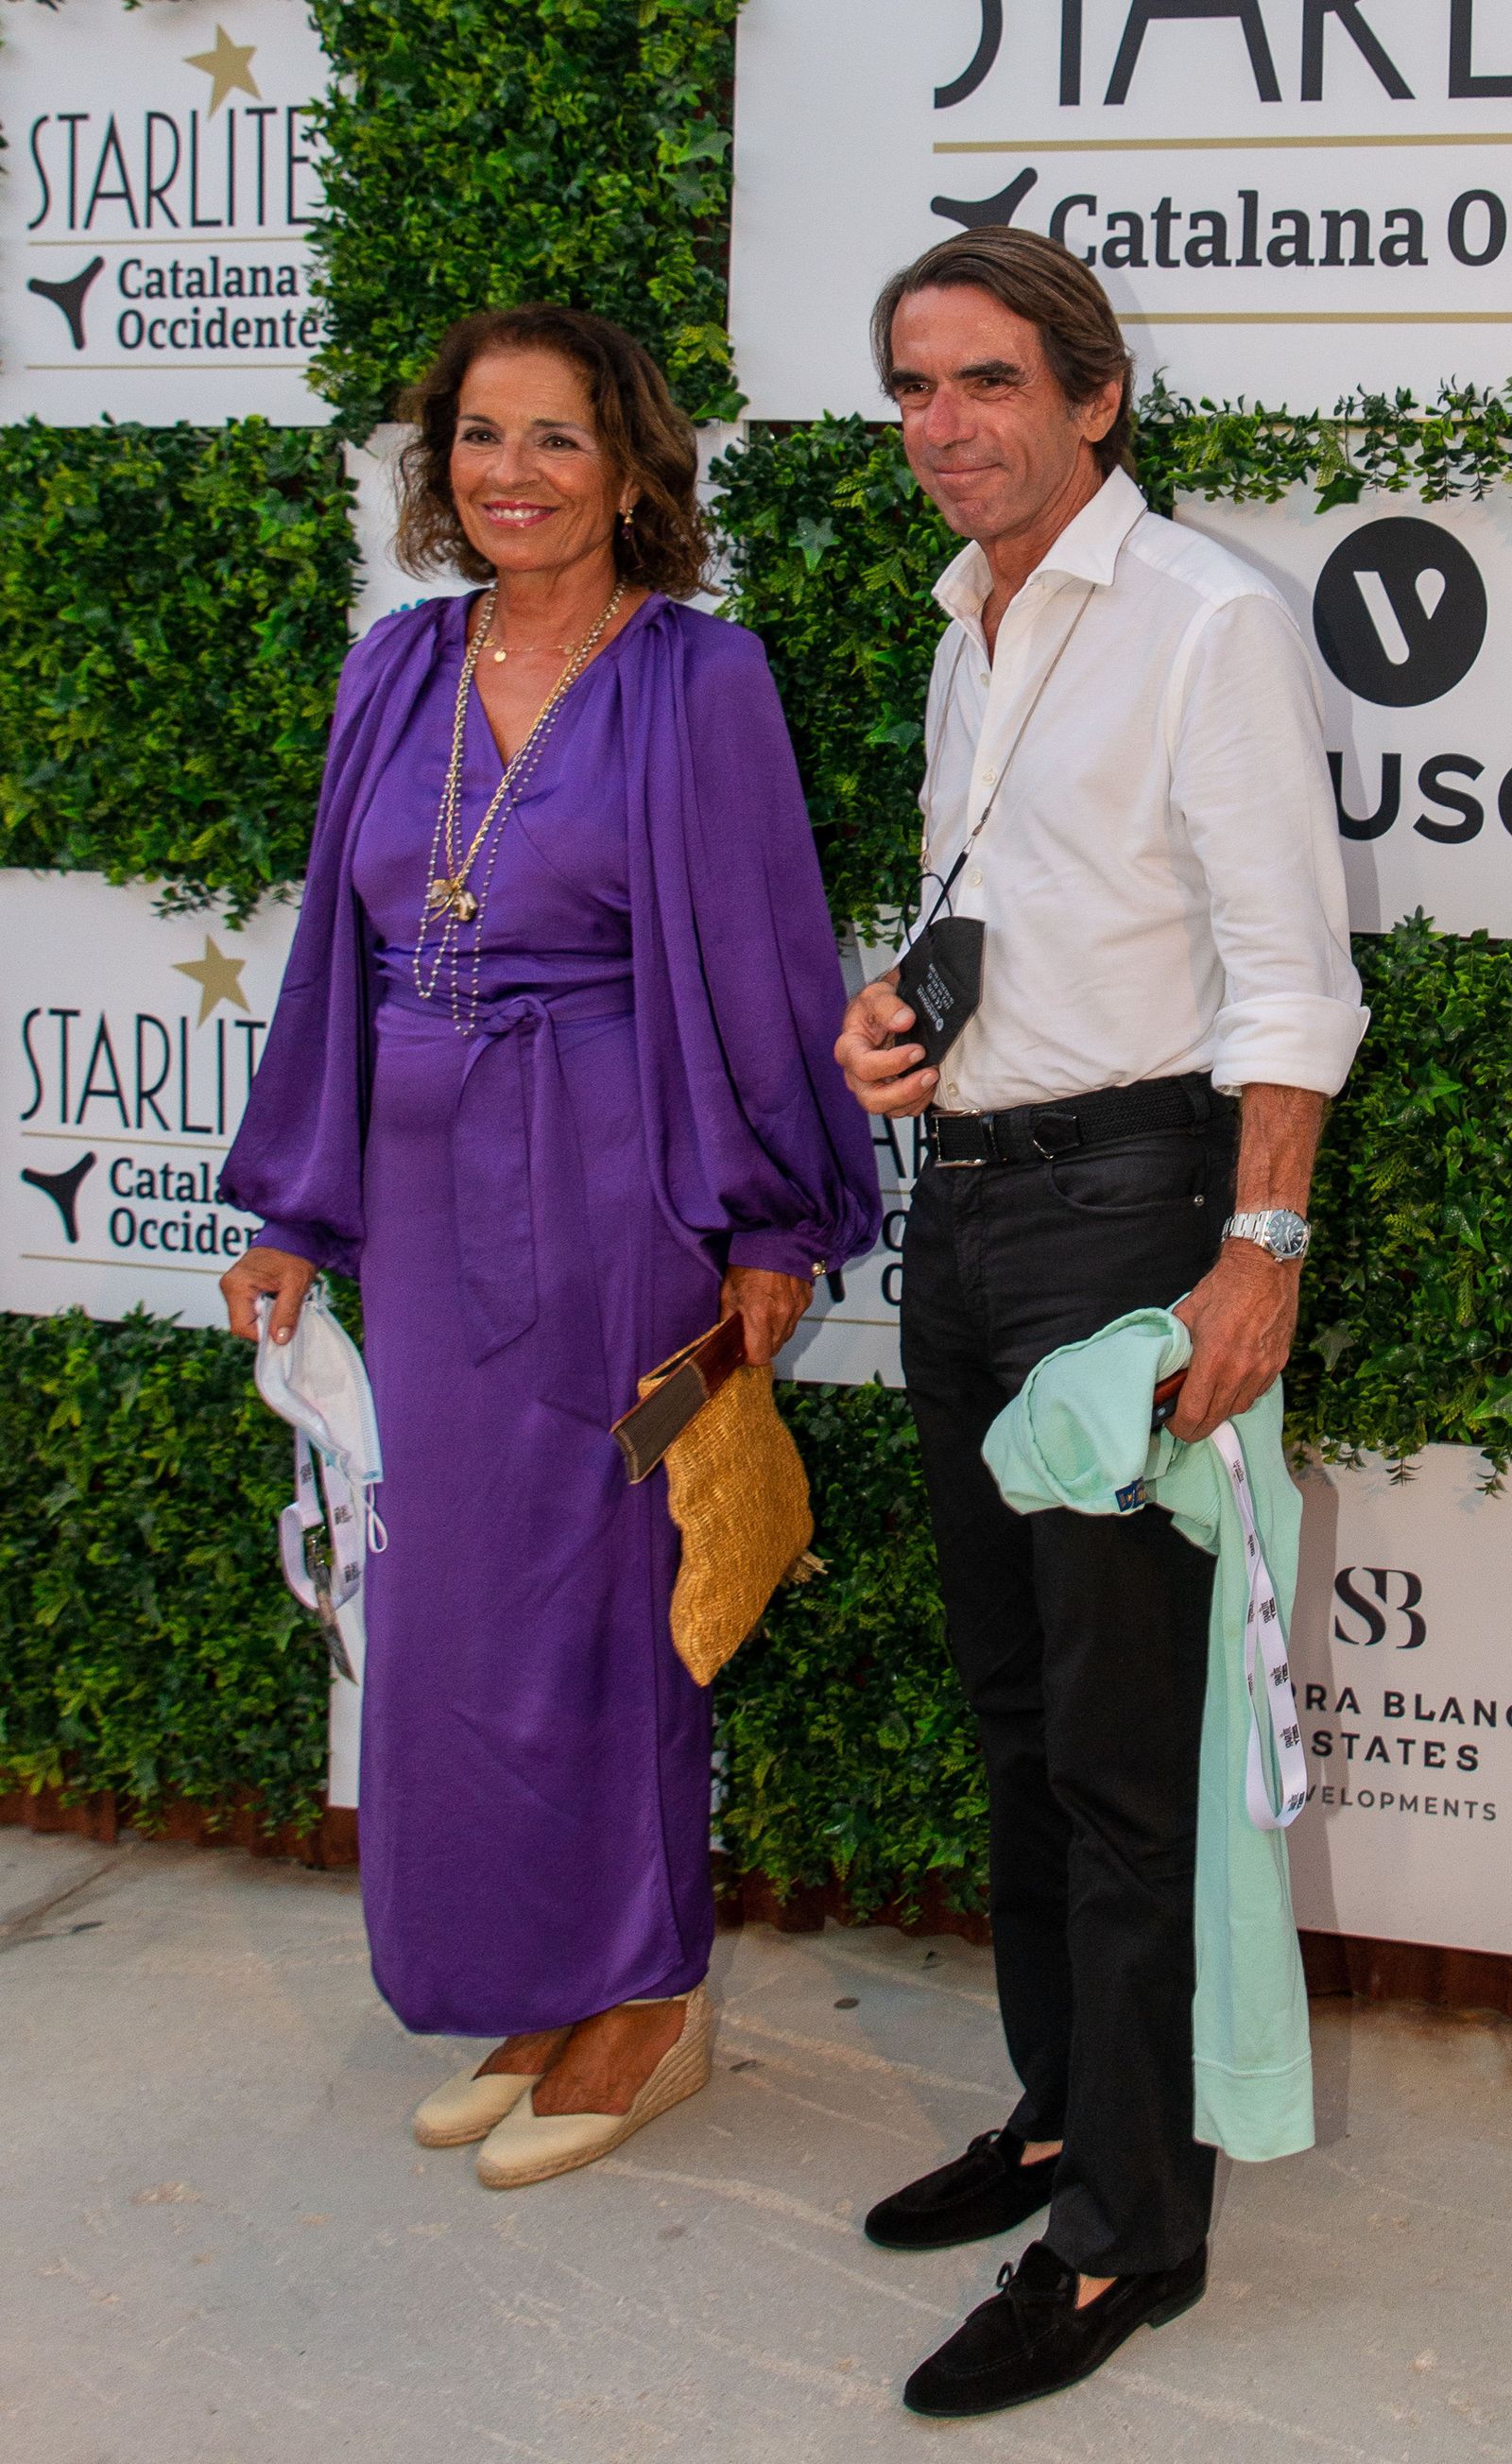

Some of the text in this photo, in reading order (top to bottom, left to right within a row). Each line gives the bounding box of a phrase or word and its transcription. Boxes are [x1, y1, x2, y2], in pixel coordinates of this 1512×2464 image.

[28, 106, 320, 231] STARLITE
[1049, 190, 1428, 268] Catalana
[118, 255, 299, 299] Catalana
[117, 306, 319, 350] Occidente
[1326, 751, 1512, 844] US
[21, 1008, 266, 1135] STARLIT
[1291, 1680, 1361, 1714] RA
[1312, 1730, 1479, 1771] STATES
